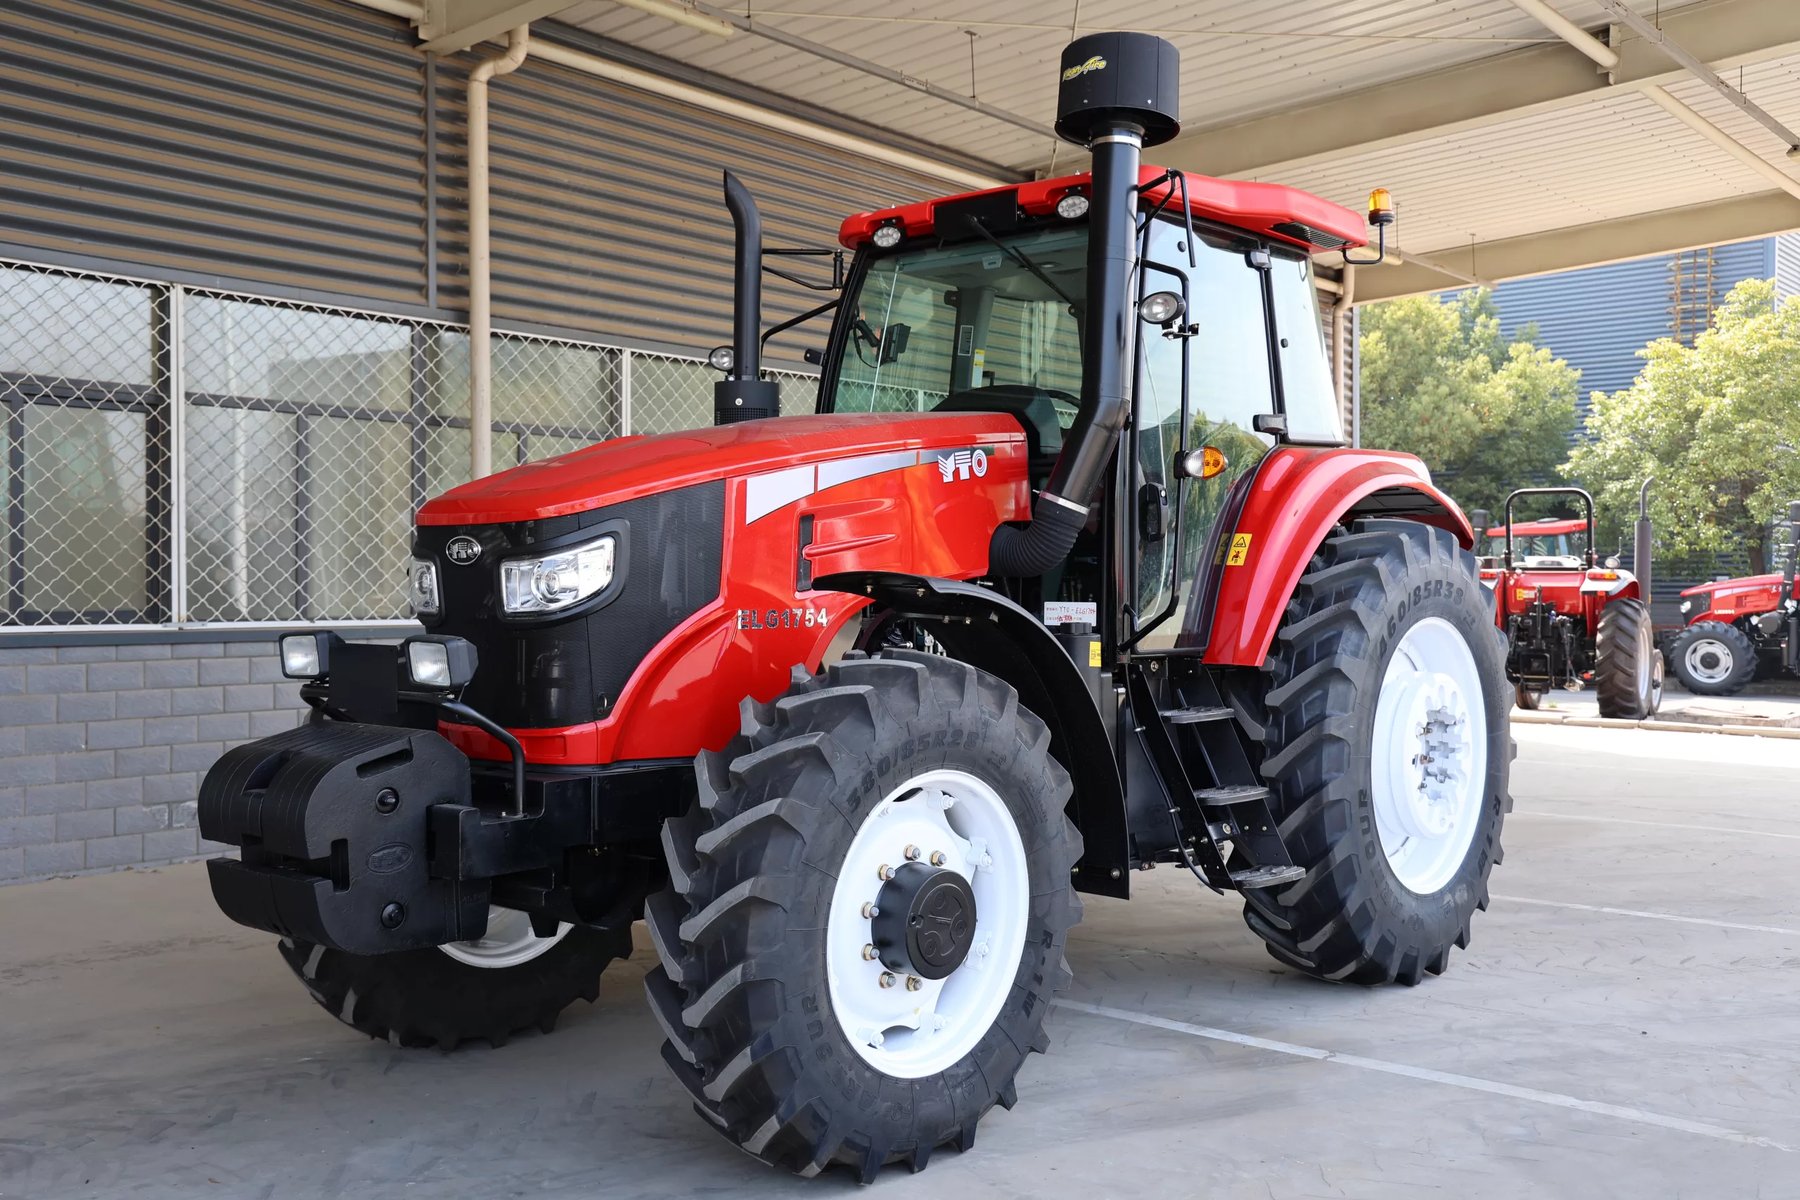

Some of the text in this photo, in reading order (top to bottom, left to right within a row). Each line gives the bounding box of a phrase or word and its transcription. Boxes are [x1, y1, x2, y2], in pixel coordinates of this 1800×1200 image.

[938, 449, 987, 483] YTO
[449, 541, 478, 560] YTO
[737, 607, 828, 630] ELG1754
[1379, 579, 1464, 660] 460/85R38
[847, 729, 980, 815] 380/85R28
[1022, 929, 1055, 1020] R-1W
